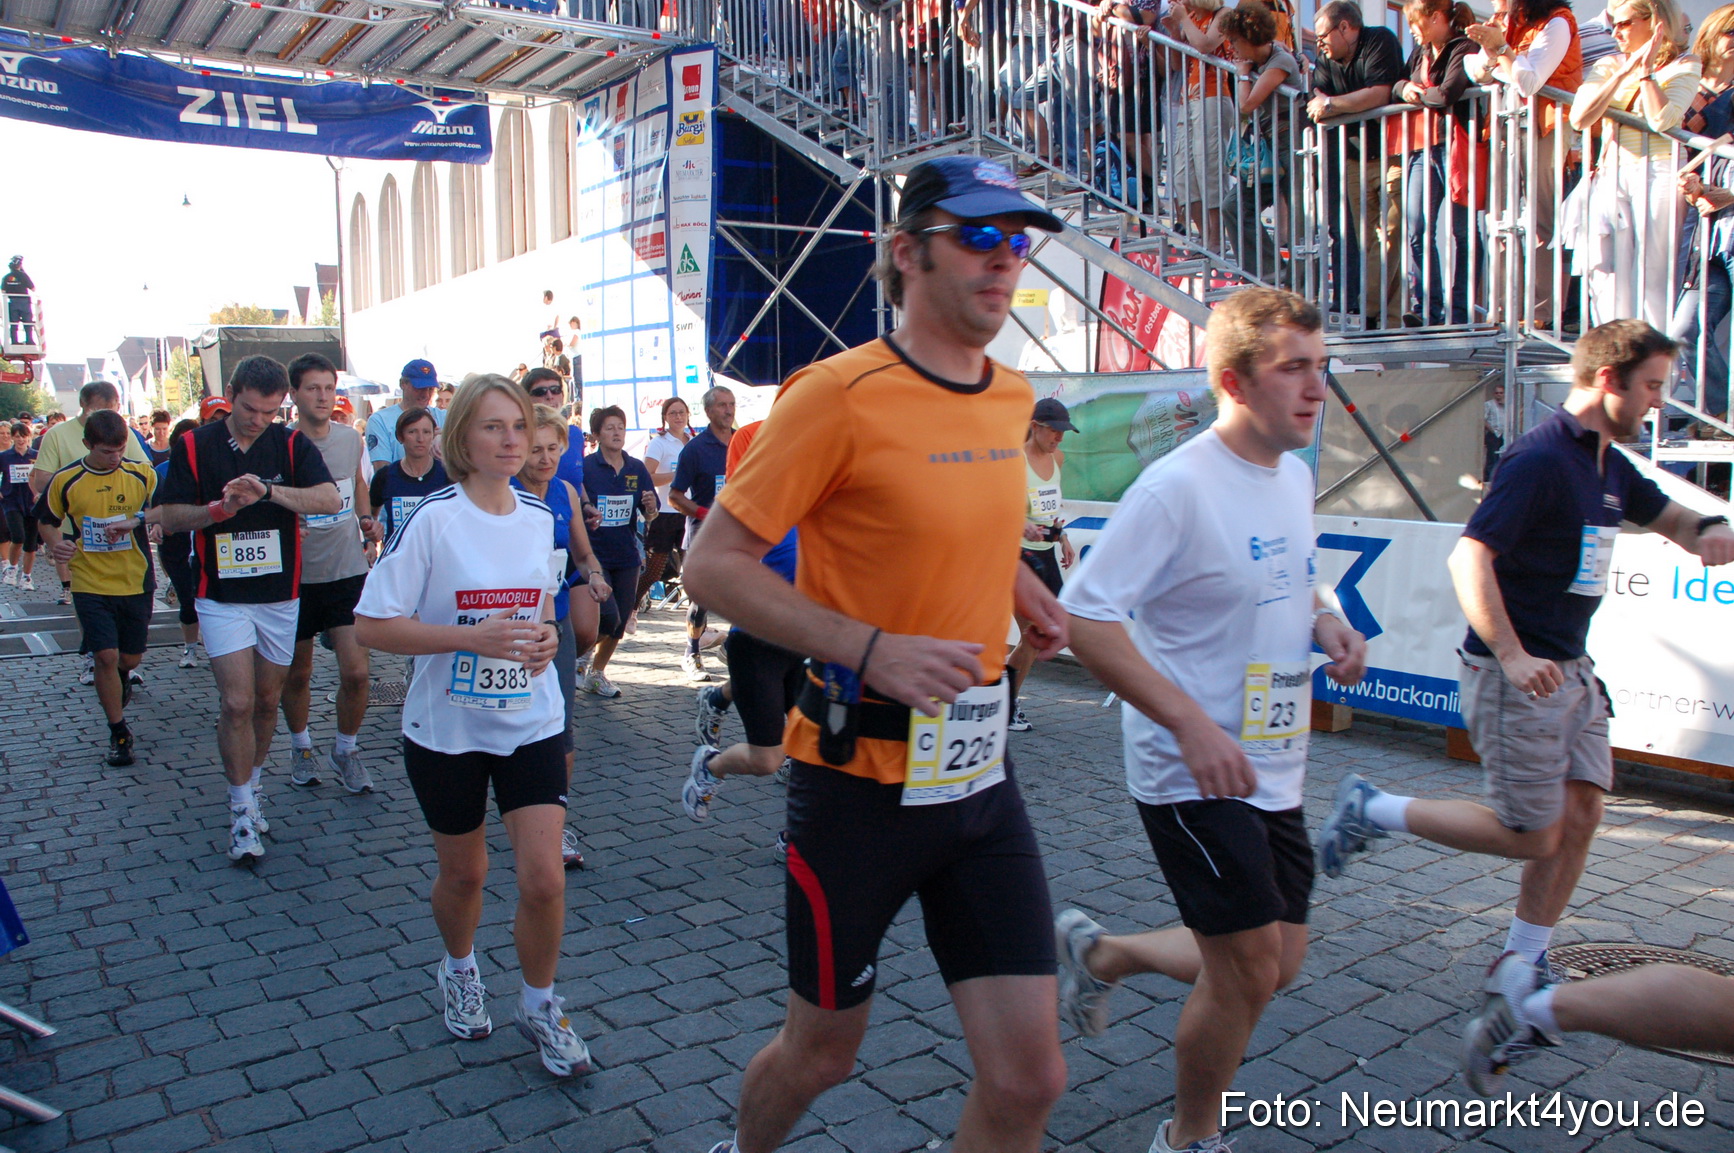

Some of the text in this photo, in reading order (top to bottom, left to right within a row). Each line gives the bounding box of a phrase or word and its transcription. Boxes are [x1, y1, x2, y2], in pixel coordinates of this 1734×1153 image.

[0, 95, 69, 112] unoeurope.com
[177, 85, 318, 135] ZIEL
[607, 508, 630, 518] 3175
[1041, 500, 1057, 511] 308
[232, 530, 271, 541] Matthias
[220, 545, 228, 554] C
[235, 546, 266, 562] 885
[1610, 565, 1650, 596] te
[460, 592, 537, 605] AUTOMOBILE
[460, 661, 471, 673] D
[479, 667, 529, 690] 3383
[1251, 697, 1261, 712] C
[1268, 701, 1297, 728] 23
[919, 732, 935, 751] C
[944, 731, 996, 771] 226
